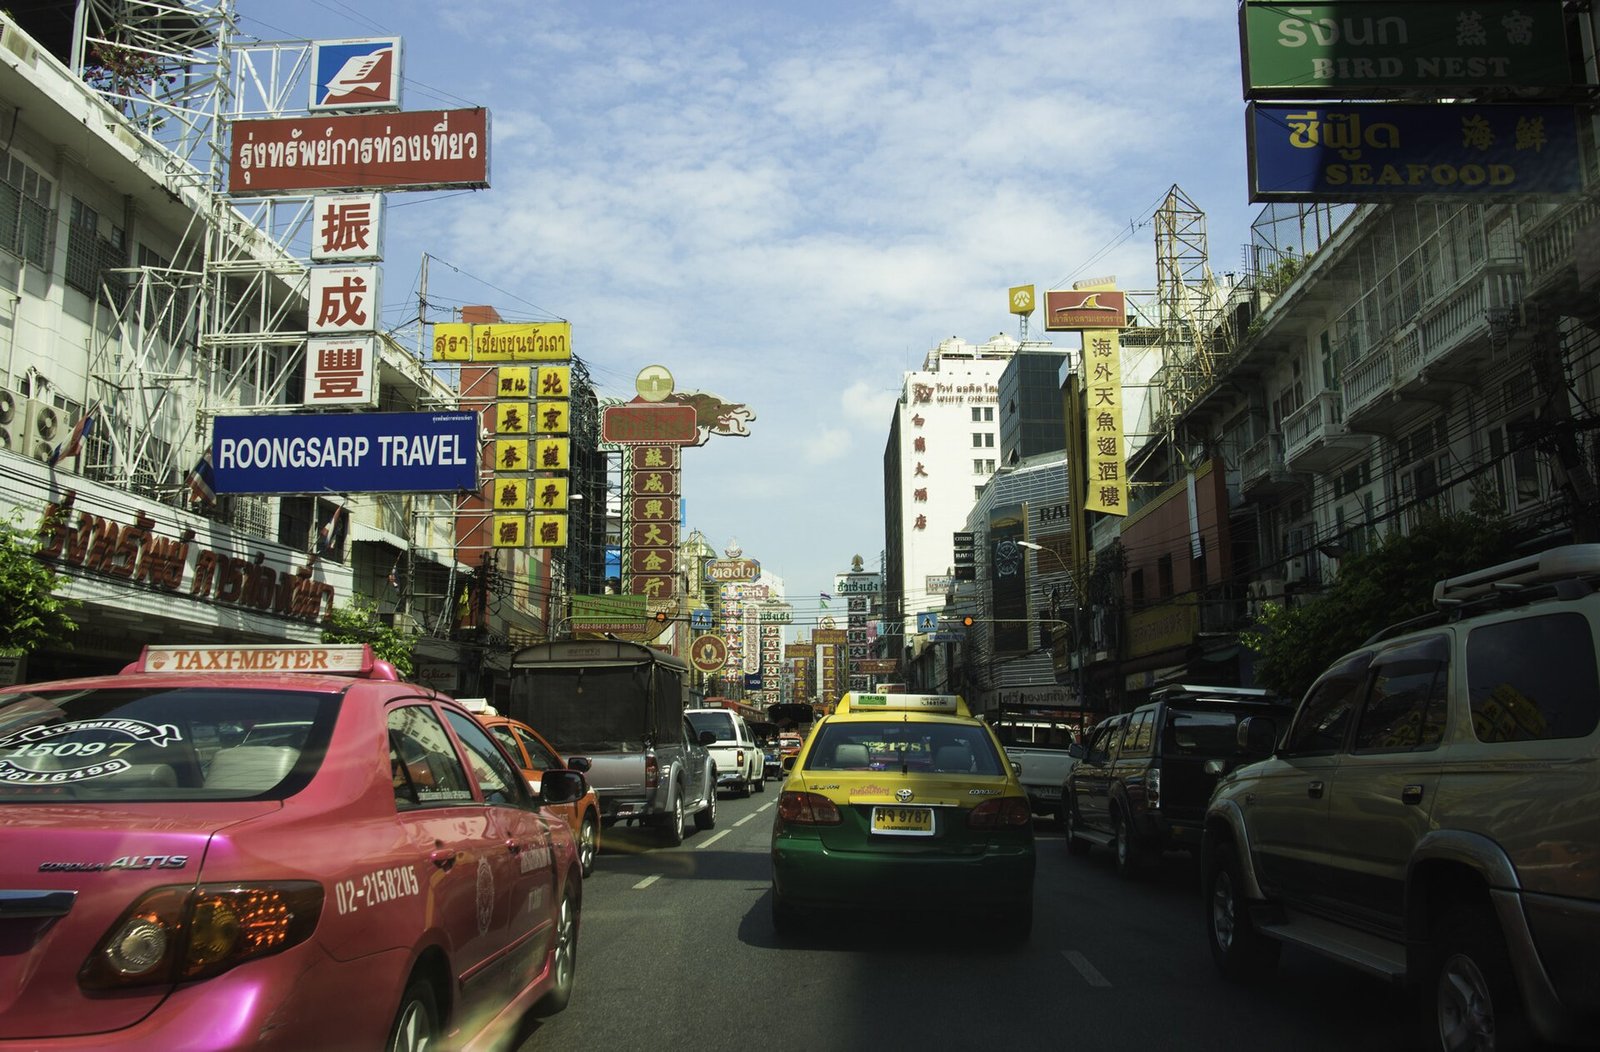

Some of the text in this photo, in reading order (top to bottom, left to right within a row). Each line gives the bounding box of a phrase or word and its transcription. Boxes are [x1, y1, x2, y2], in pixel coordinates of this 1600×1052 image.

[1277, 8, 1408, 48] รังนก
[1456, 10, 1535, 46] 燕窩
[1311, 56, 1510, 79] BIRD NEST
[1462, 115, 1547, 152] 海鮮
[239, 113, 478, 185] รุ่งทรัพย์การท่องเที่ยว
[1326, 164, 1516, 185] SEAFOOD
[435, 333, 468, 360] สุรา
[936, 395, 963, 403] WHITE
[1092, 338, 1120, 507] 海外天魚翅酒樓
[219, 434, 467, 469] ROONGSARP TRAVEL
[173, 650, 330, 671] TAXI-METER
[5, 743, 136, 758] 15097
[900, 809, 930, 823] 9787
[108, 855, 188, 870] ALTIS
[335, 866, 419, 915] 02-2158205
